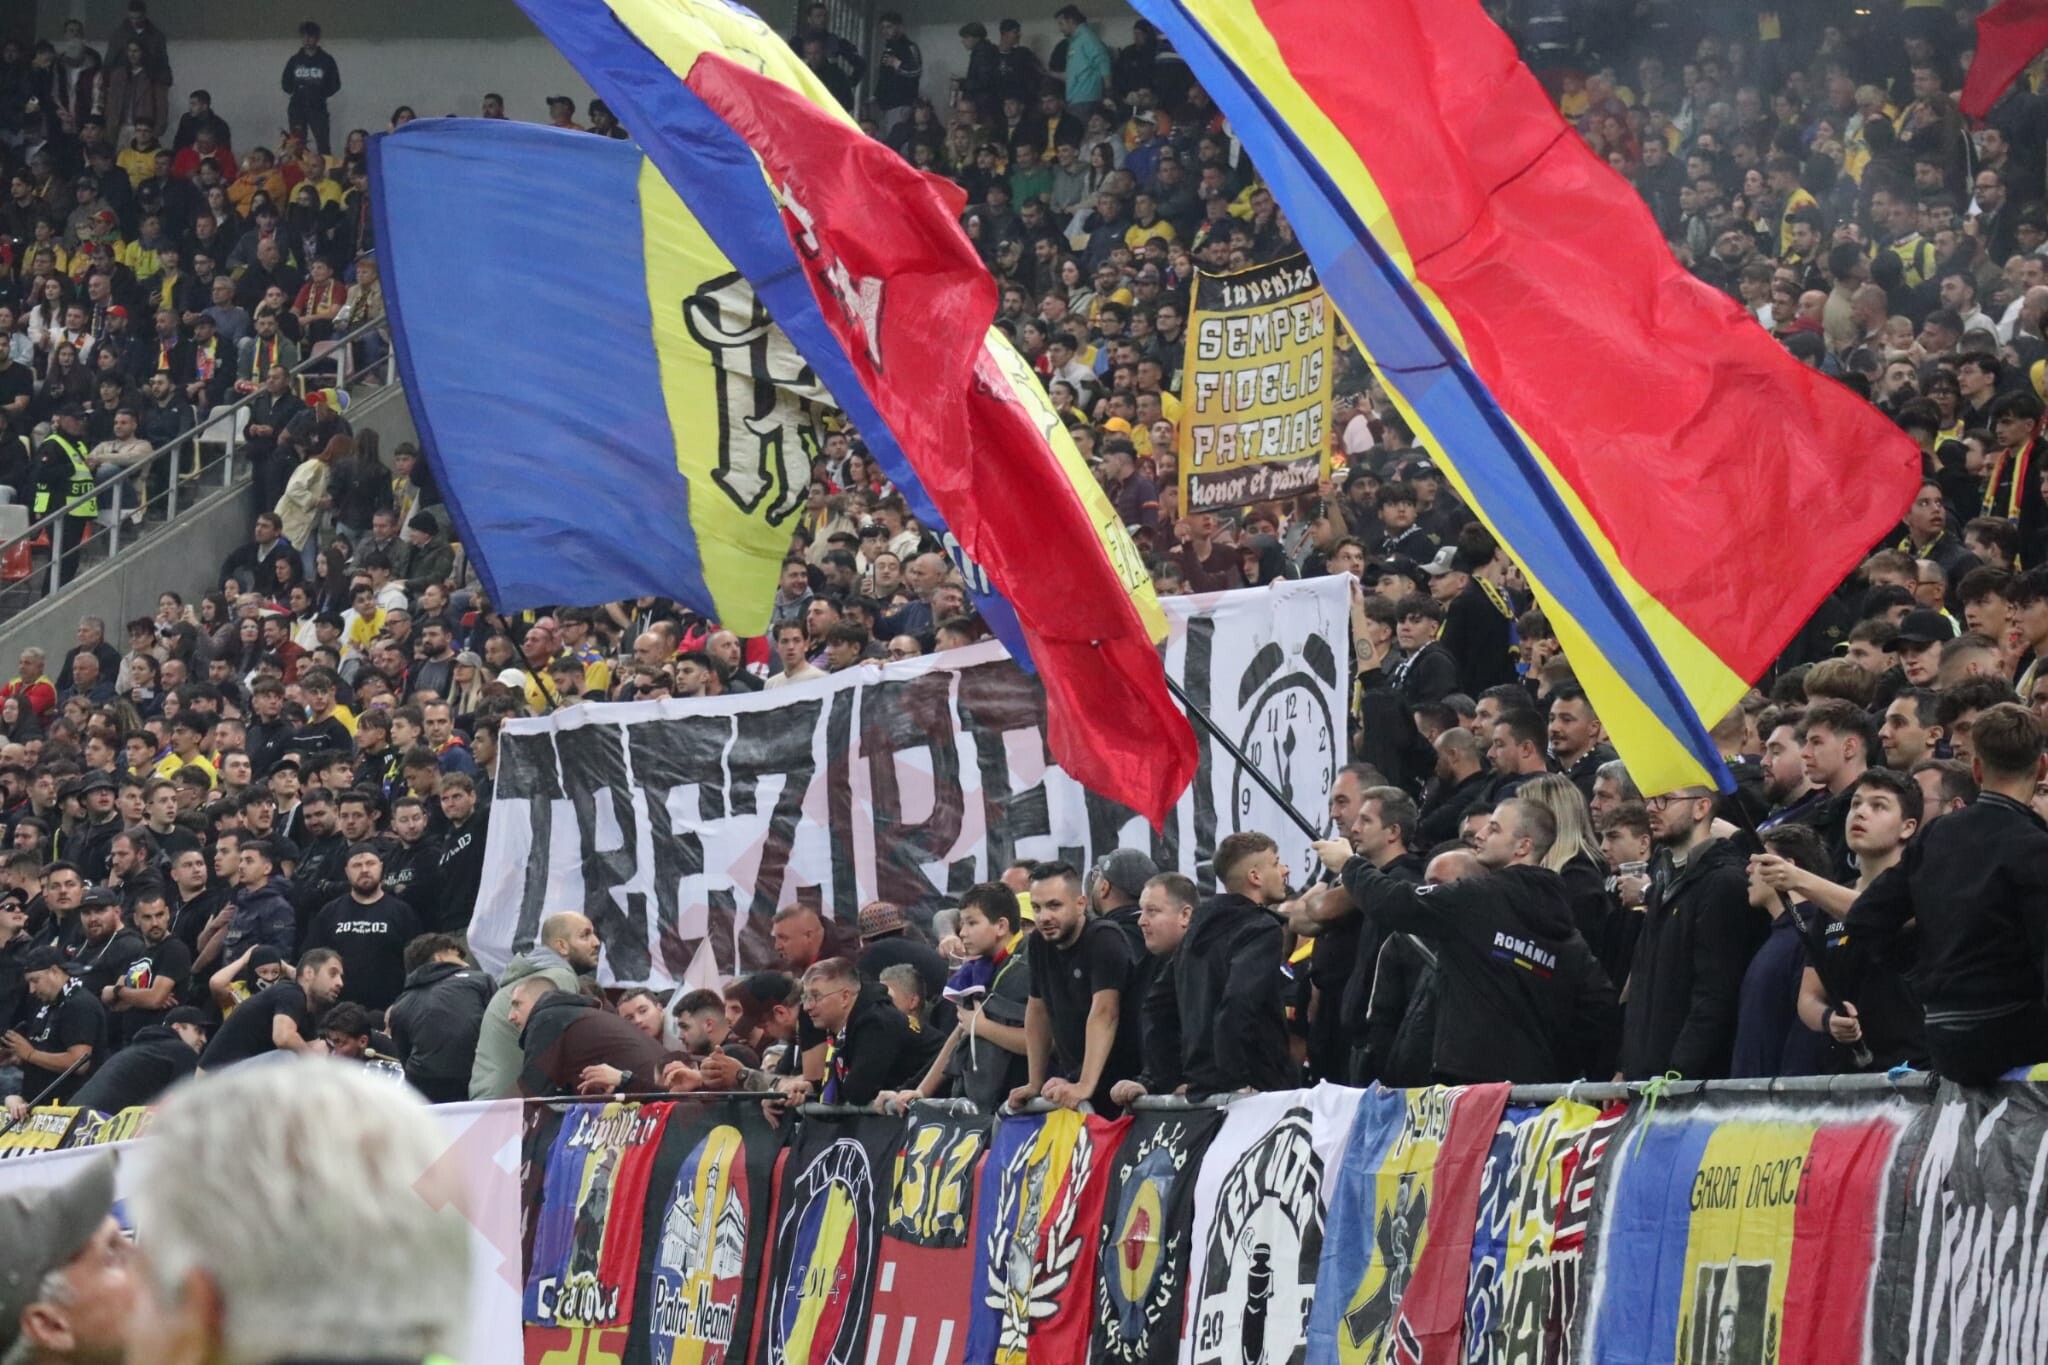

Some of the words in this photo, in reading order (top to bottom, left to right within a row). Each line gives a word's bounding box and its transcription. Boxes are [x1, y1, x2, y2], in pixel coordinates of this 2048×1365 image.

[1198, 293, 1325, 361] SEMPER
[1195, 347, 1323, 413] FIDELIS
[1192, 400, 1323, 466] PATRIAE
[1190, 475, 1247, 505] honor
[1250, 465, 1270, 495] et
[1286, 692, 1298, 720] 12
[1267, 708, 1278, 733] 11
[1318, 726, 1327, 752] 2
[1251, 740, 1262, 767] 10
[1321, 767, 1330, 795] 3
[1241, 788, 1251, 815] 9
[371, 921, 388, 934] 03
[1493, 931, 1557, 969] ROMÂNIA
[1689, 1166, 1742, 1212] GARDA
[1745, 1155, 1814, 1209] DACICA
